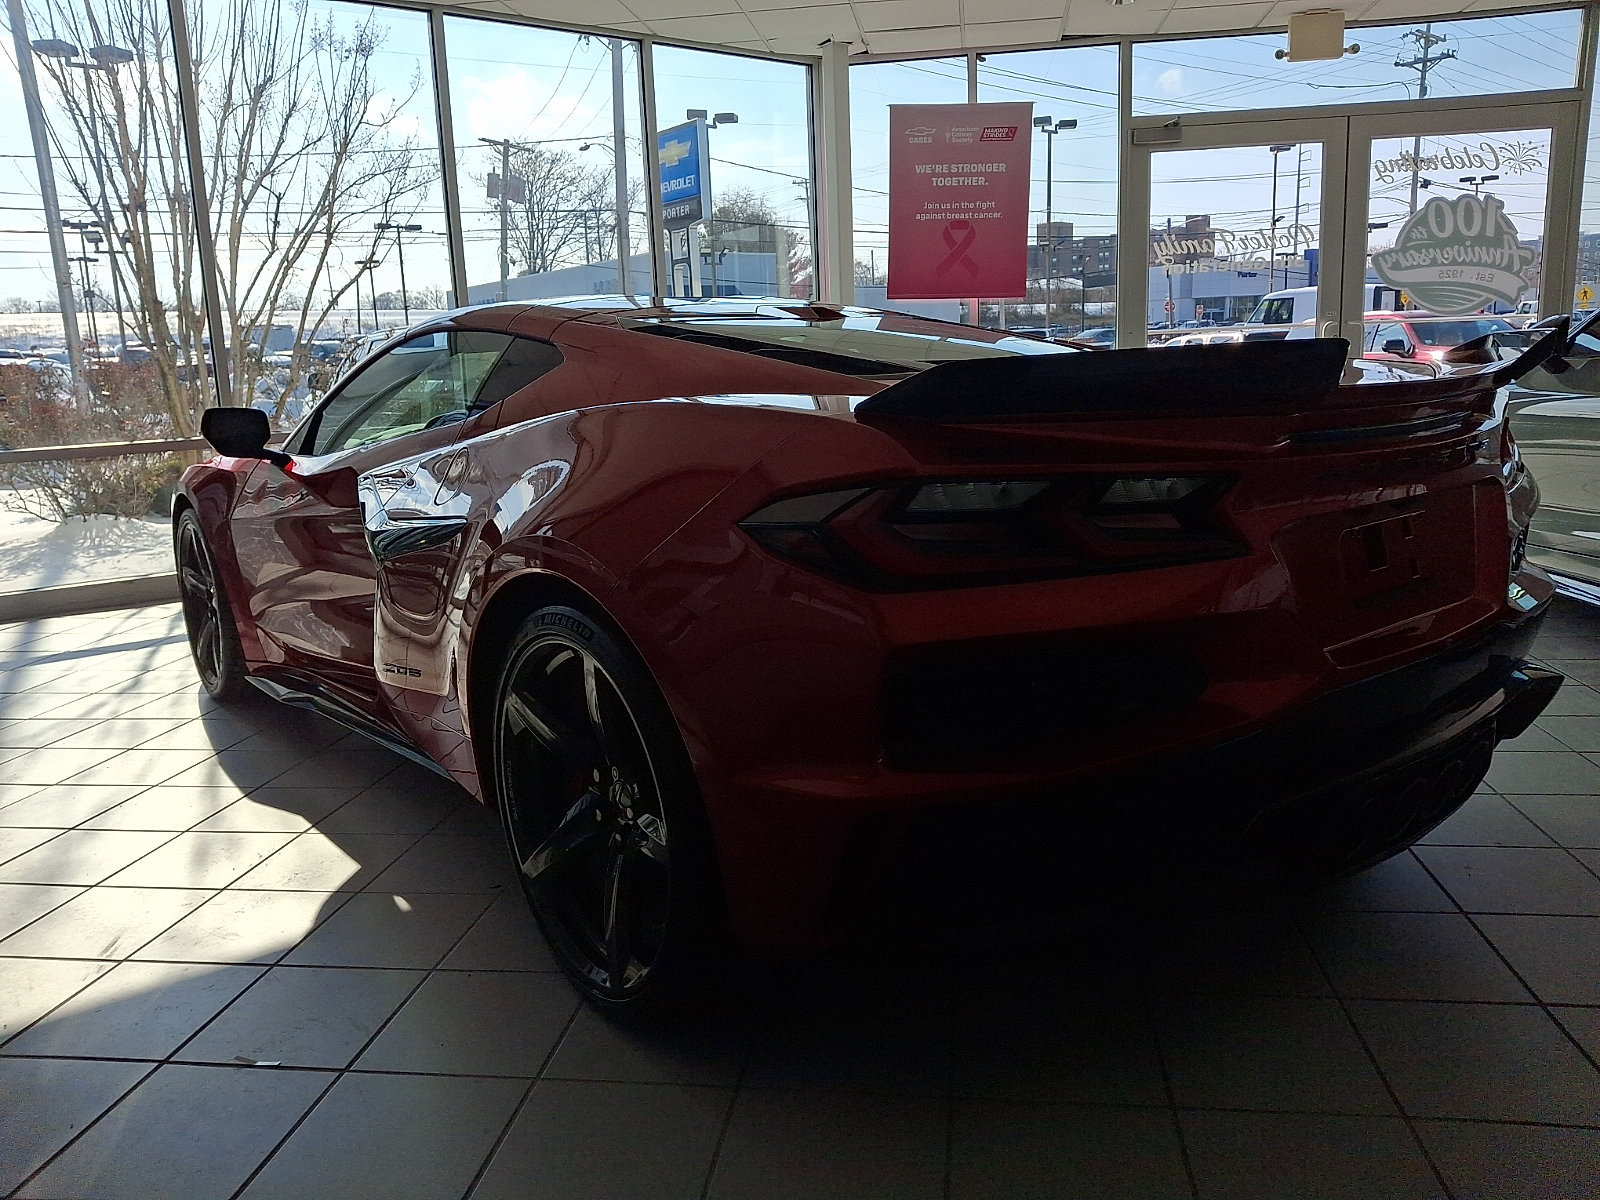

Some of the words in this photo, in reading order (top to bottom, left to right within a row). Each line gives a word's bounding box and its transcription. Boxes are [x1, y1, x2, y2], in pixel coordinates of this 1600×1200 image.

[950, 163, 1006, 173] STRONGER
[660, 174, 696, 194] EVROLET
[931, 176, 989, 187] TOGETHER.
[923, 201, 940, 209] Join
[952, 201, 960, 209] in
[961, 201, 975, 209] the
[976, 200, 996, 210] fight
[662, 204, 690, 219] PORTER
[915, 212, 945, 221] against
[946, 211, 973, 220] breast
[974, 211, 1003, 219] cancer.
[543, 614, 592, 639] MICHELIN
